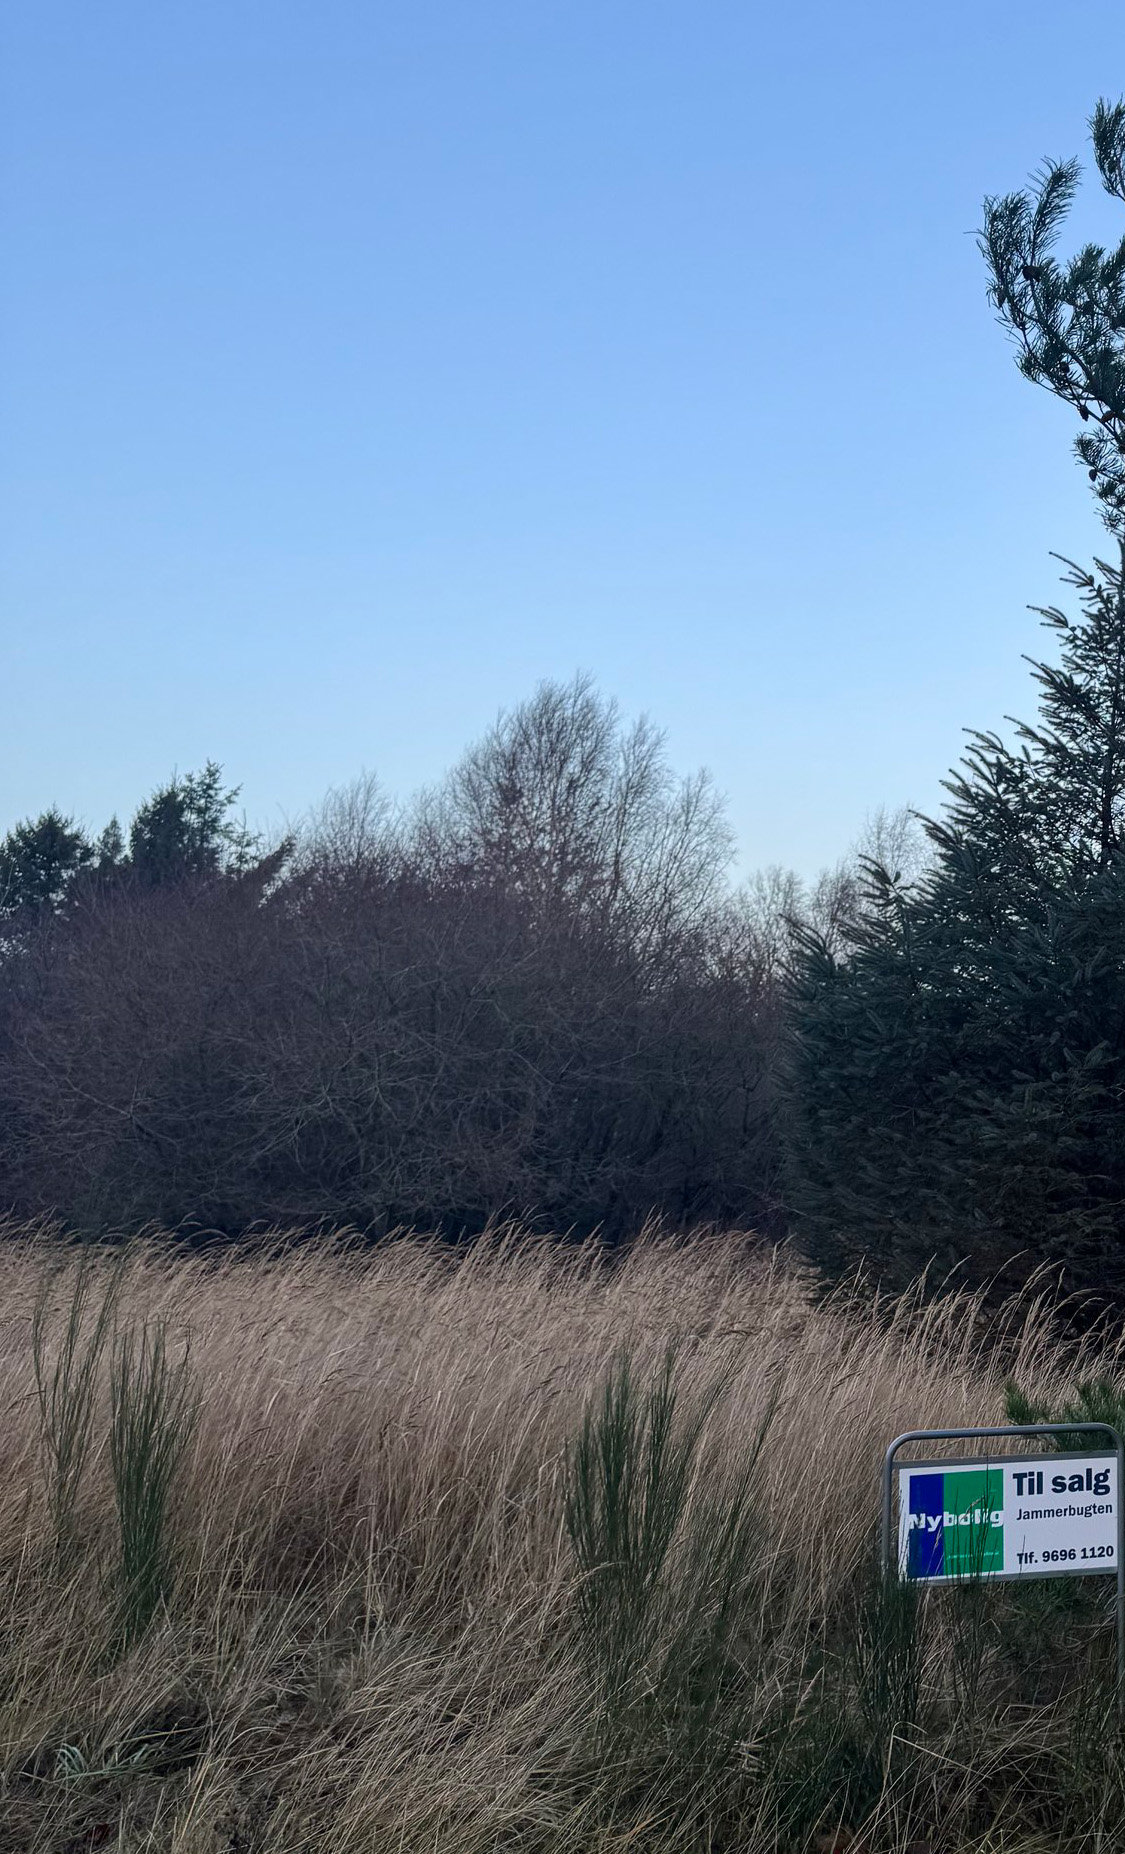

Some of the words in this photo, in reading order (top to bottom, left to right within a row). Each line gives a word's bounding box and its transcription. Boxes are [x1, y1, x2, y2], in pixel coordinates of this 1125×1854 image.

[1013, 1471, 1044, 1496] Til
[1051, 1468, 1111, 1496] salg
[1017, 1503, 1113, 1520] Jammerbugten
[1017, 1551, 1038, 1564] Tlf.
[1042, 1548, 1076, 1563] 9696
[1080, 1546, 1114, 1560] 1120
